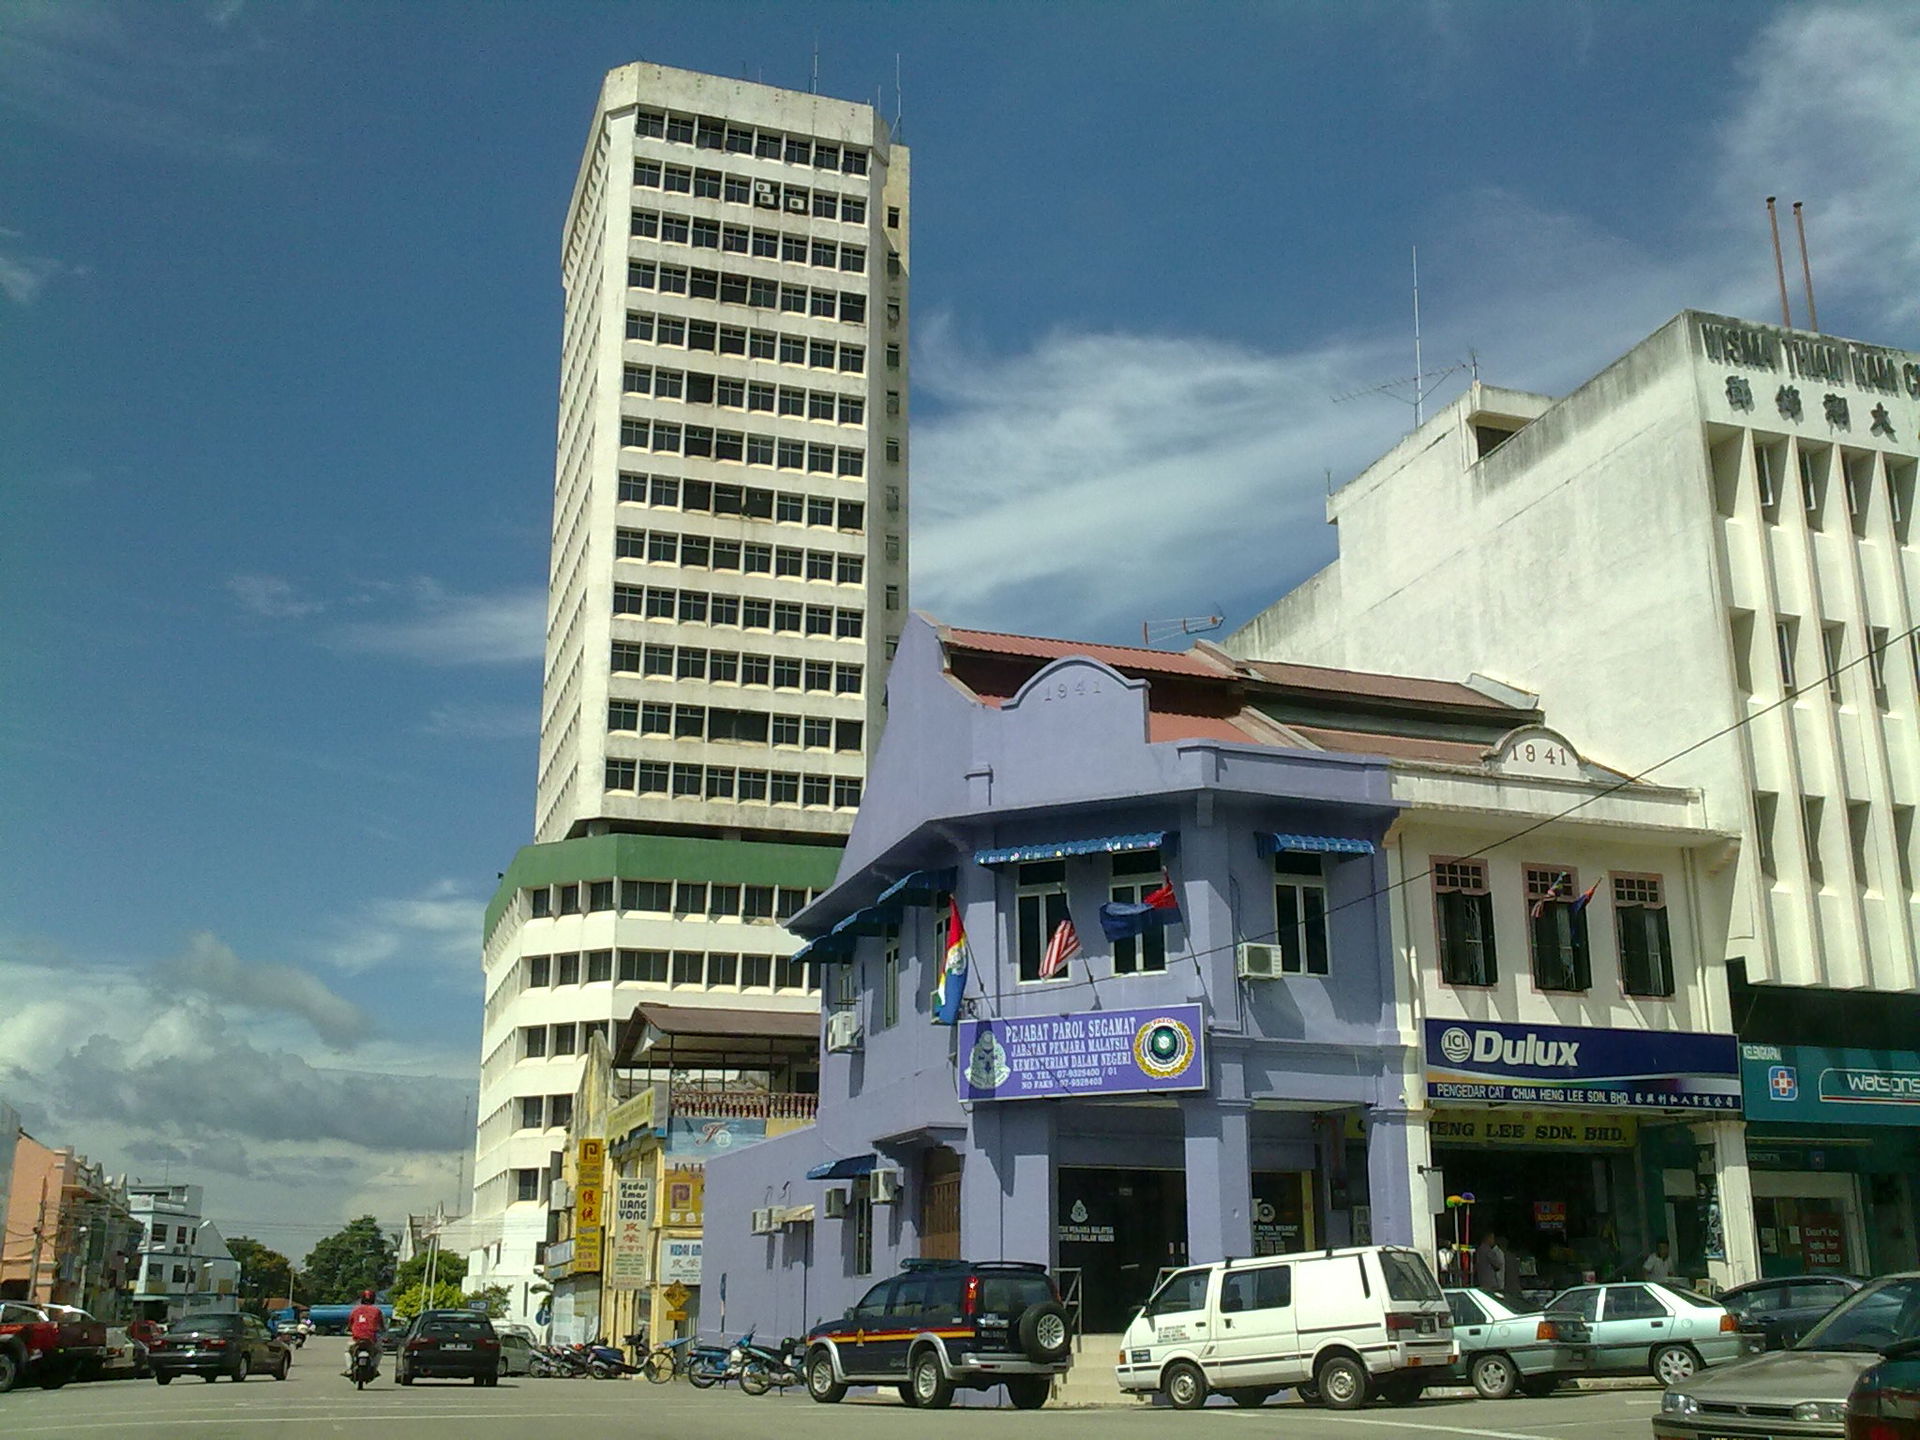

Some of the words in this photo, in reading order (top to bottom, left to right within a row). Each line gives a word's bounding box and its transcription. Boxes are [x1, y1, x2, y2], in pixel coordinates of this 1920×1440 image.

[1044, 680, 1101, 701] 1941
[1005, 1023, 1049, 1043] PEJABAT
[1052, 1020, 1085, 1040] PAROL
[1088, 1017, 1136, 1037] SEGAMAT
[1011, 1042, 1047, 1057] JABATAN
[1049, 1039, 1086, 1055] PENJARA
[1088, 1036, 1130, 1052] MALAYSIA
[1448, 1034, 1465, 1048] ICI
[1473, 1030, 1580, 1067] Dulux
[1012, 1055, 1069, 1071] KEMENTERIAN
[1071, 1053, 1098, 1068] DALAM
[1100, 1051, 1131, 1066] NEGERI
[1437, 1083, 1486, 1098] PENGEDAR
[1488, 1086, 1505, 1099] CAT
[1512, 1087, 1536, 1100] CHUA
[1540, 1088, 1564, 1101] HENG
[1567, 1090, 1584, 1102] LEE
[1486, 1123, 1525, 1138] LEE
[1536, 1125, 1577, 1140] SDN.
[1584, 1127, 1627, 1142] BHD.
[618, 1210, 647, 1220] YONG
